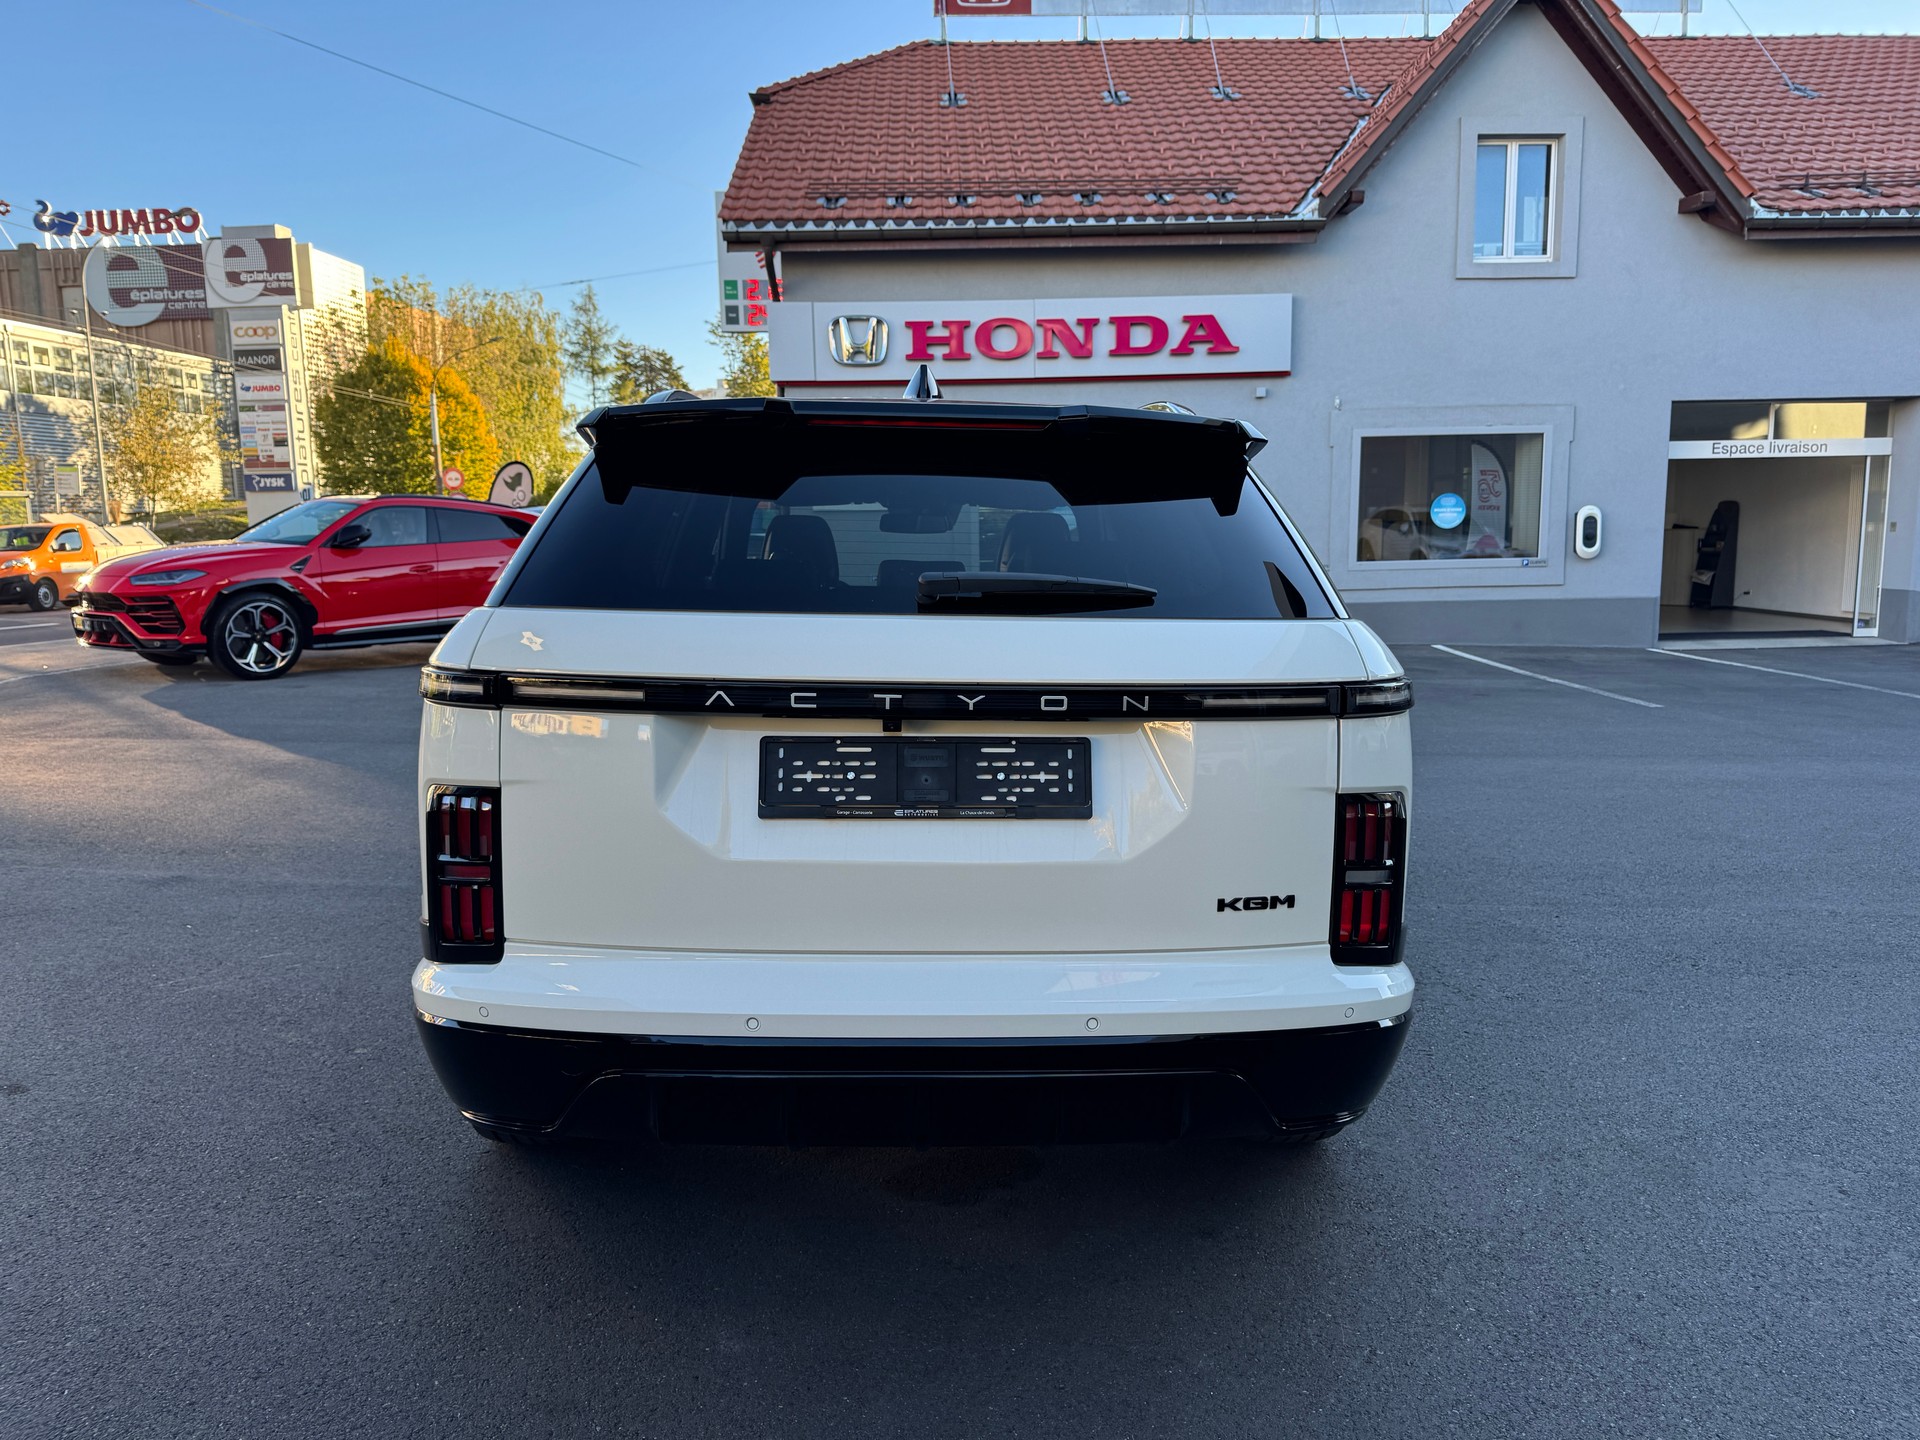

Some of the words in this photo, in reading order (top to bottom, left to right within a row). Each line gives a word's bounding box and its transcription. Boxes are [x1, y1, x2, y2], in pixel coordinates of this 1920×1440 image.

[80, 207, 200, 236] JUMBO
[130, 288, 205, 302] éplatures
[167, 301, 206, 309] centre
[234, 326, 277, 340] coop
[905, 314, 1240, 361] HONDA
[237, 355, 276, 365] MANOR
[1711, 442, 1764, 457] Espace
[1769, 440, 1828, 455] livraison
[259, 477, 285, 488] JYSK
[1217, 894, 1295, 912] KGM
